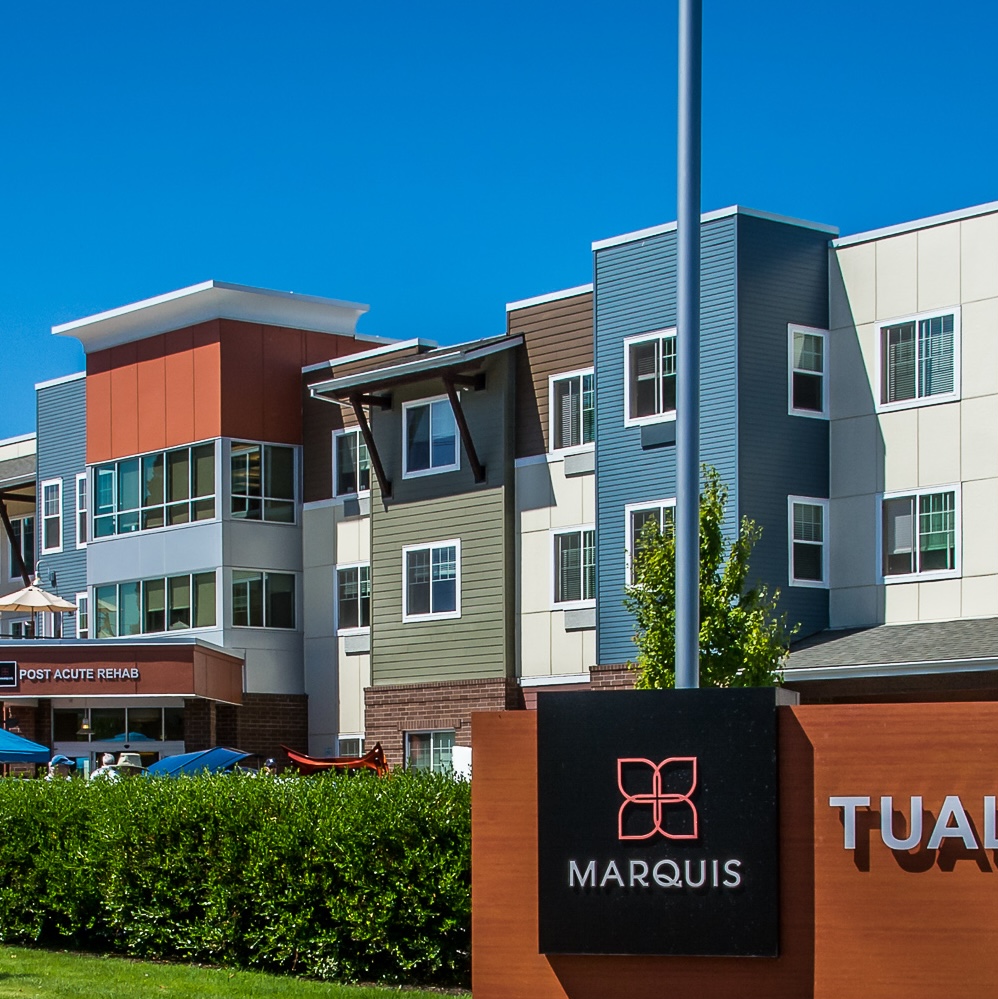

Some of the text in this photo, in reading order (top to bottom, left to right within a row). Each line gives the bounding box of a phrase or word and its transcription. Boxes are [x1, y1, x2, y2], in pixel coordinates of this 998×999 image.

[19, 668, 139, 680] POST ACUTE REHAB
[568, 859, 742, 888] MARQUIS
